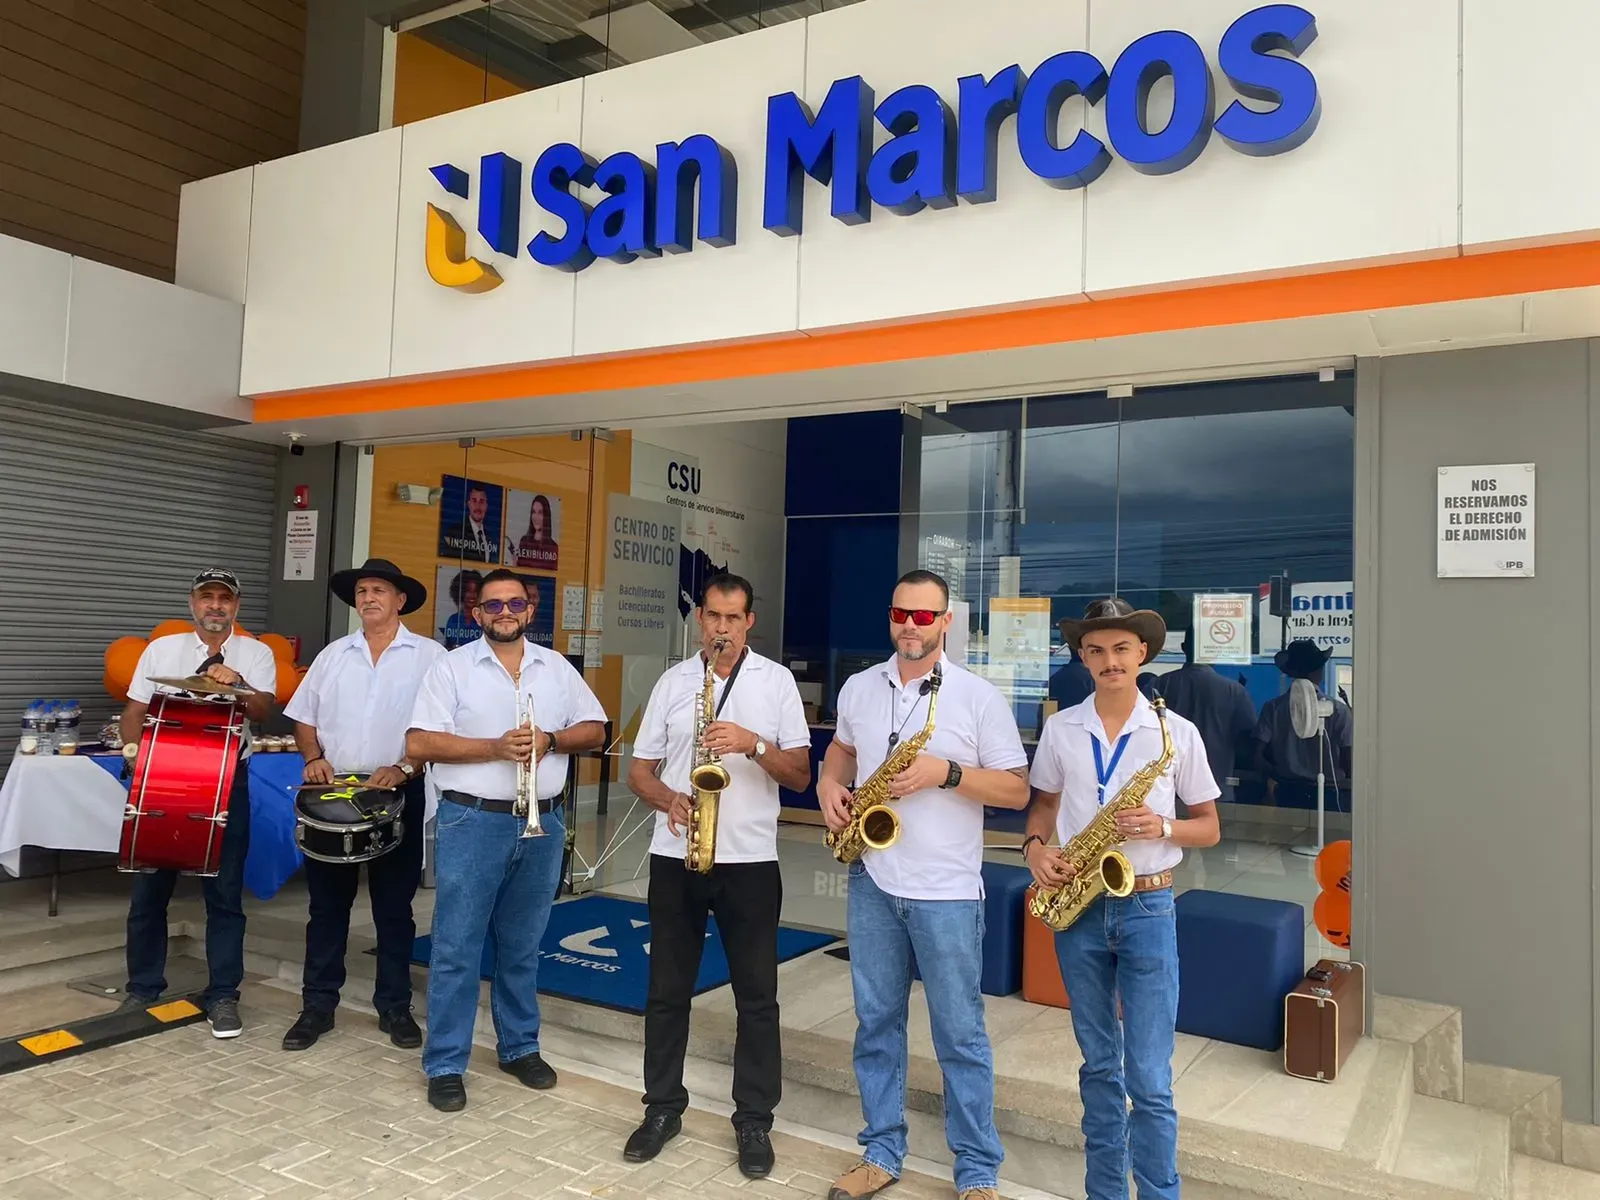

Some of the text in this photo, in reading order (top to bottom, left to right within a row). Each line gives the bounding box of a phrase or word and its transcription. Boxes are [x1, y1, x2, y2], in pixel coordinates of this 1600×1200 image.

[528, 4, 1321, 272] San Marcos
[667, 461, 701, 494] CSU
[1471, 479, 1497, 491] NOS
[666, 495, 687, 508] Centros
[688, 501, 696, 509] de
[715, 505, 745, 520] Universitario
[1444, 495, 1528, 508] RESERVAMOS
[1449, 511, 1522, 525] EL DERECHO
[614, 516, 658, 539] CENTRO
[662, 525, 675, 542] DE
[1445, 526, 1527, 541] DE ADMISIÓN
[450, 537, 498, 553] INSPIRACIÓN
[613, 539, 674, 567] SERVICIO
[1506, 561, 1524, 569] IPB
[619, 584, 666, 599] Bachilleratos
[618, 600, 665, 614] Licenciaturas
[617, 616, 664, 629] Cursos Libres
[544, 953, 622, 973] Marcos
